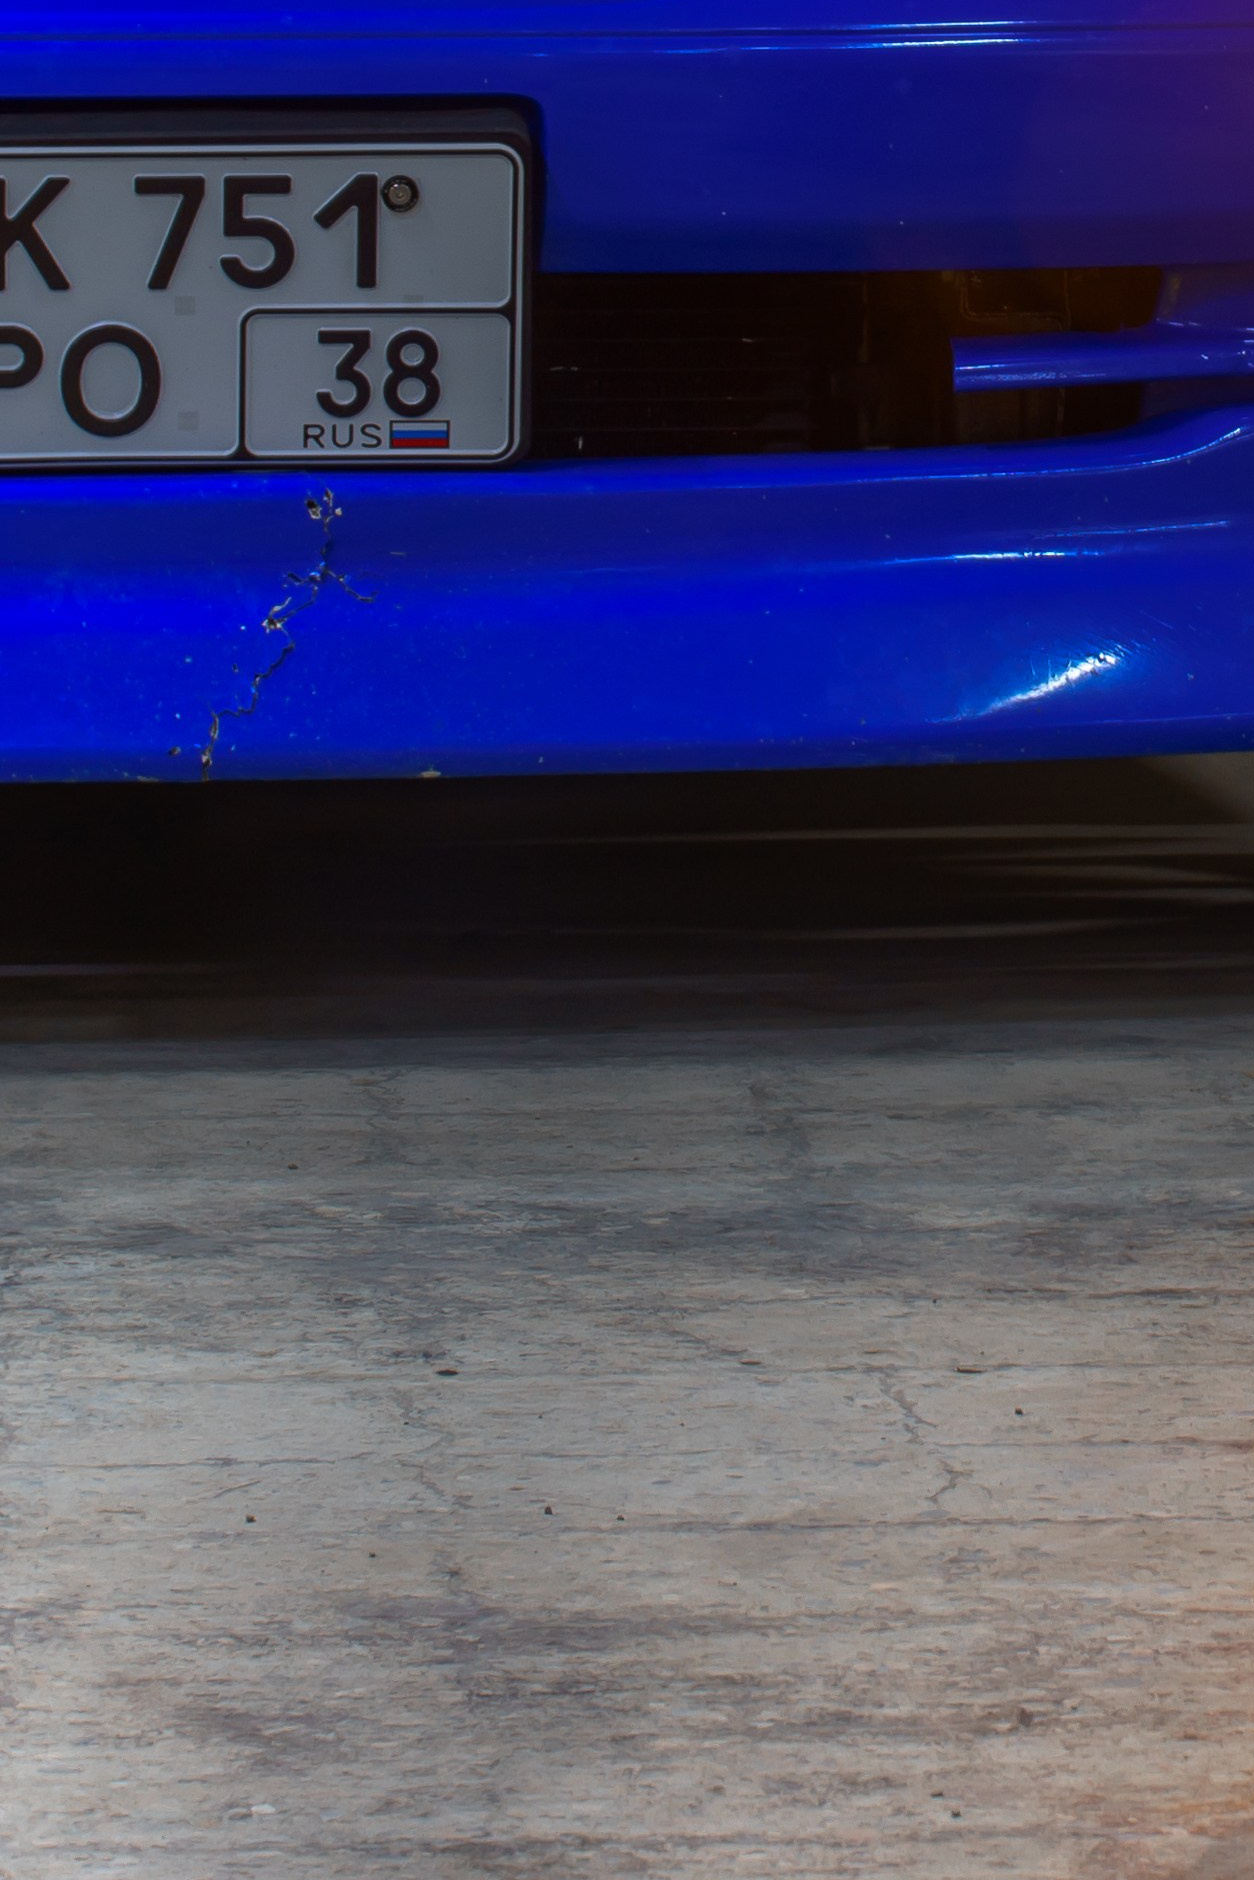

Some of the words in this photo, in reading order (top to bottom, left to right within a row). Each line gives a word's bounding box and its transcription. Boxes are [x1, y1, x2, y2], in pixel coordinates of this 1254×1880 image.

[132, 172, 380, 290] 751
[315, 328, 441, 418] 38
[302, 423, 383, 449] RUS
